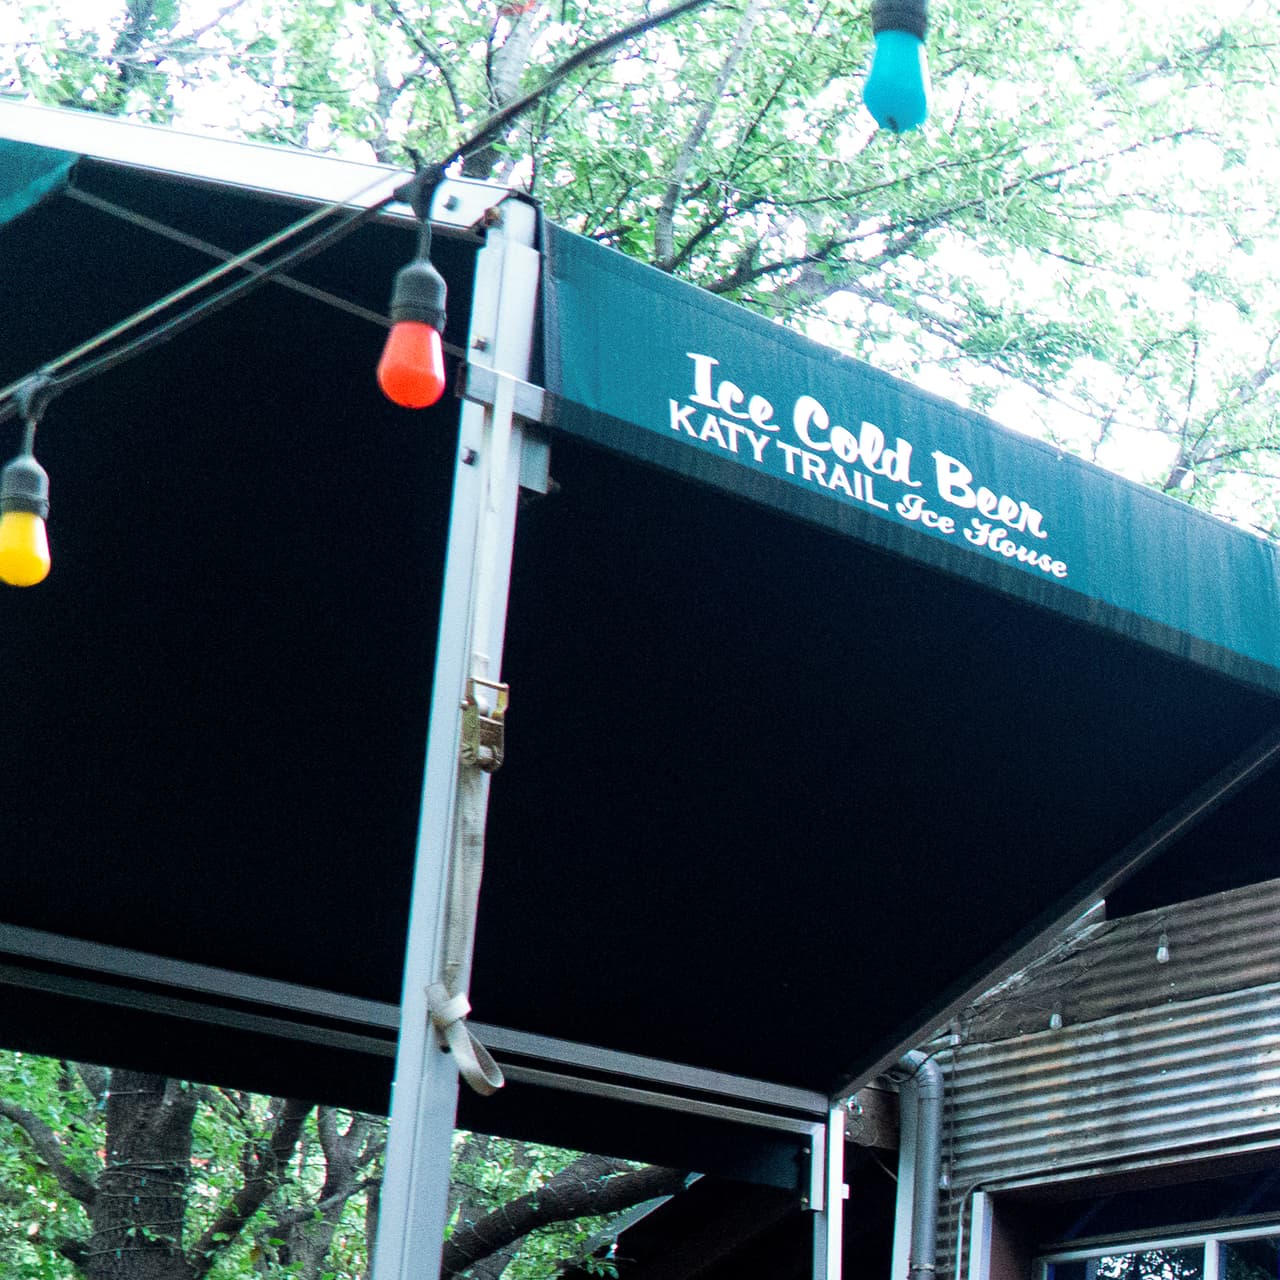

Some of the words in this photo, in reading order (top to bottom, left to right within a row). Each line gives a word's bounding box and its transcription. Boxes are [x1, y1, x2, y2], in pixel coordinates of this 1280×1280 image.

[669, 398, 771, 463] KATY
[776, 438, 889, 512] TRAIL
[896, 493, 956, 534] Ice
[963, 516, 1069, 579] House
[686, 351, 781, 432] Ice
[793, 395, 922, 488] Cold
[931, 449, 1048, 539] Beer
